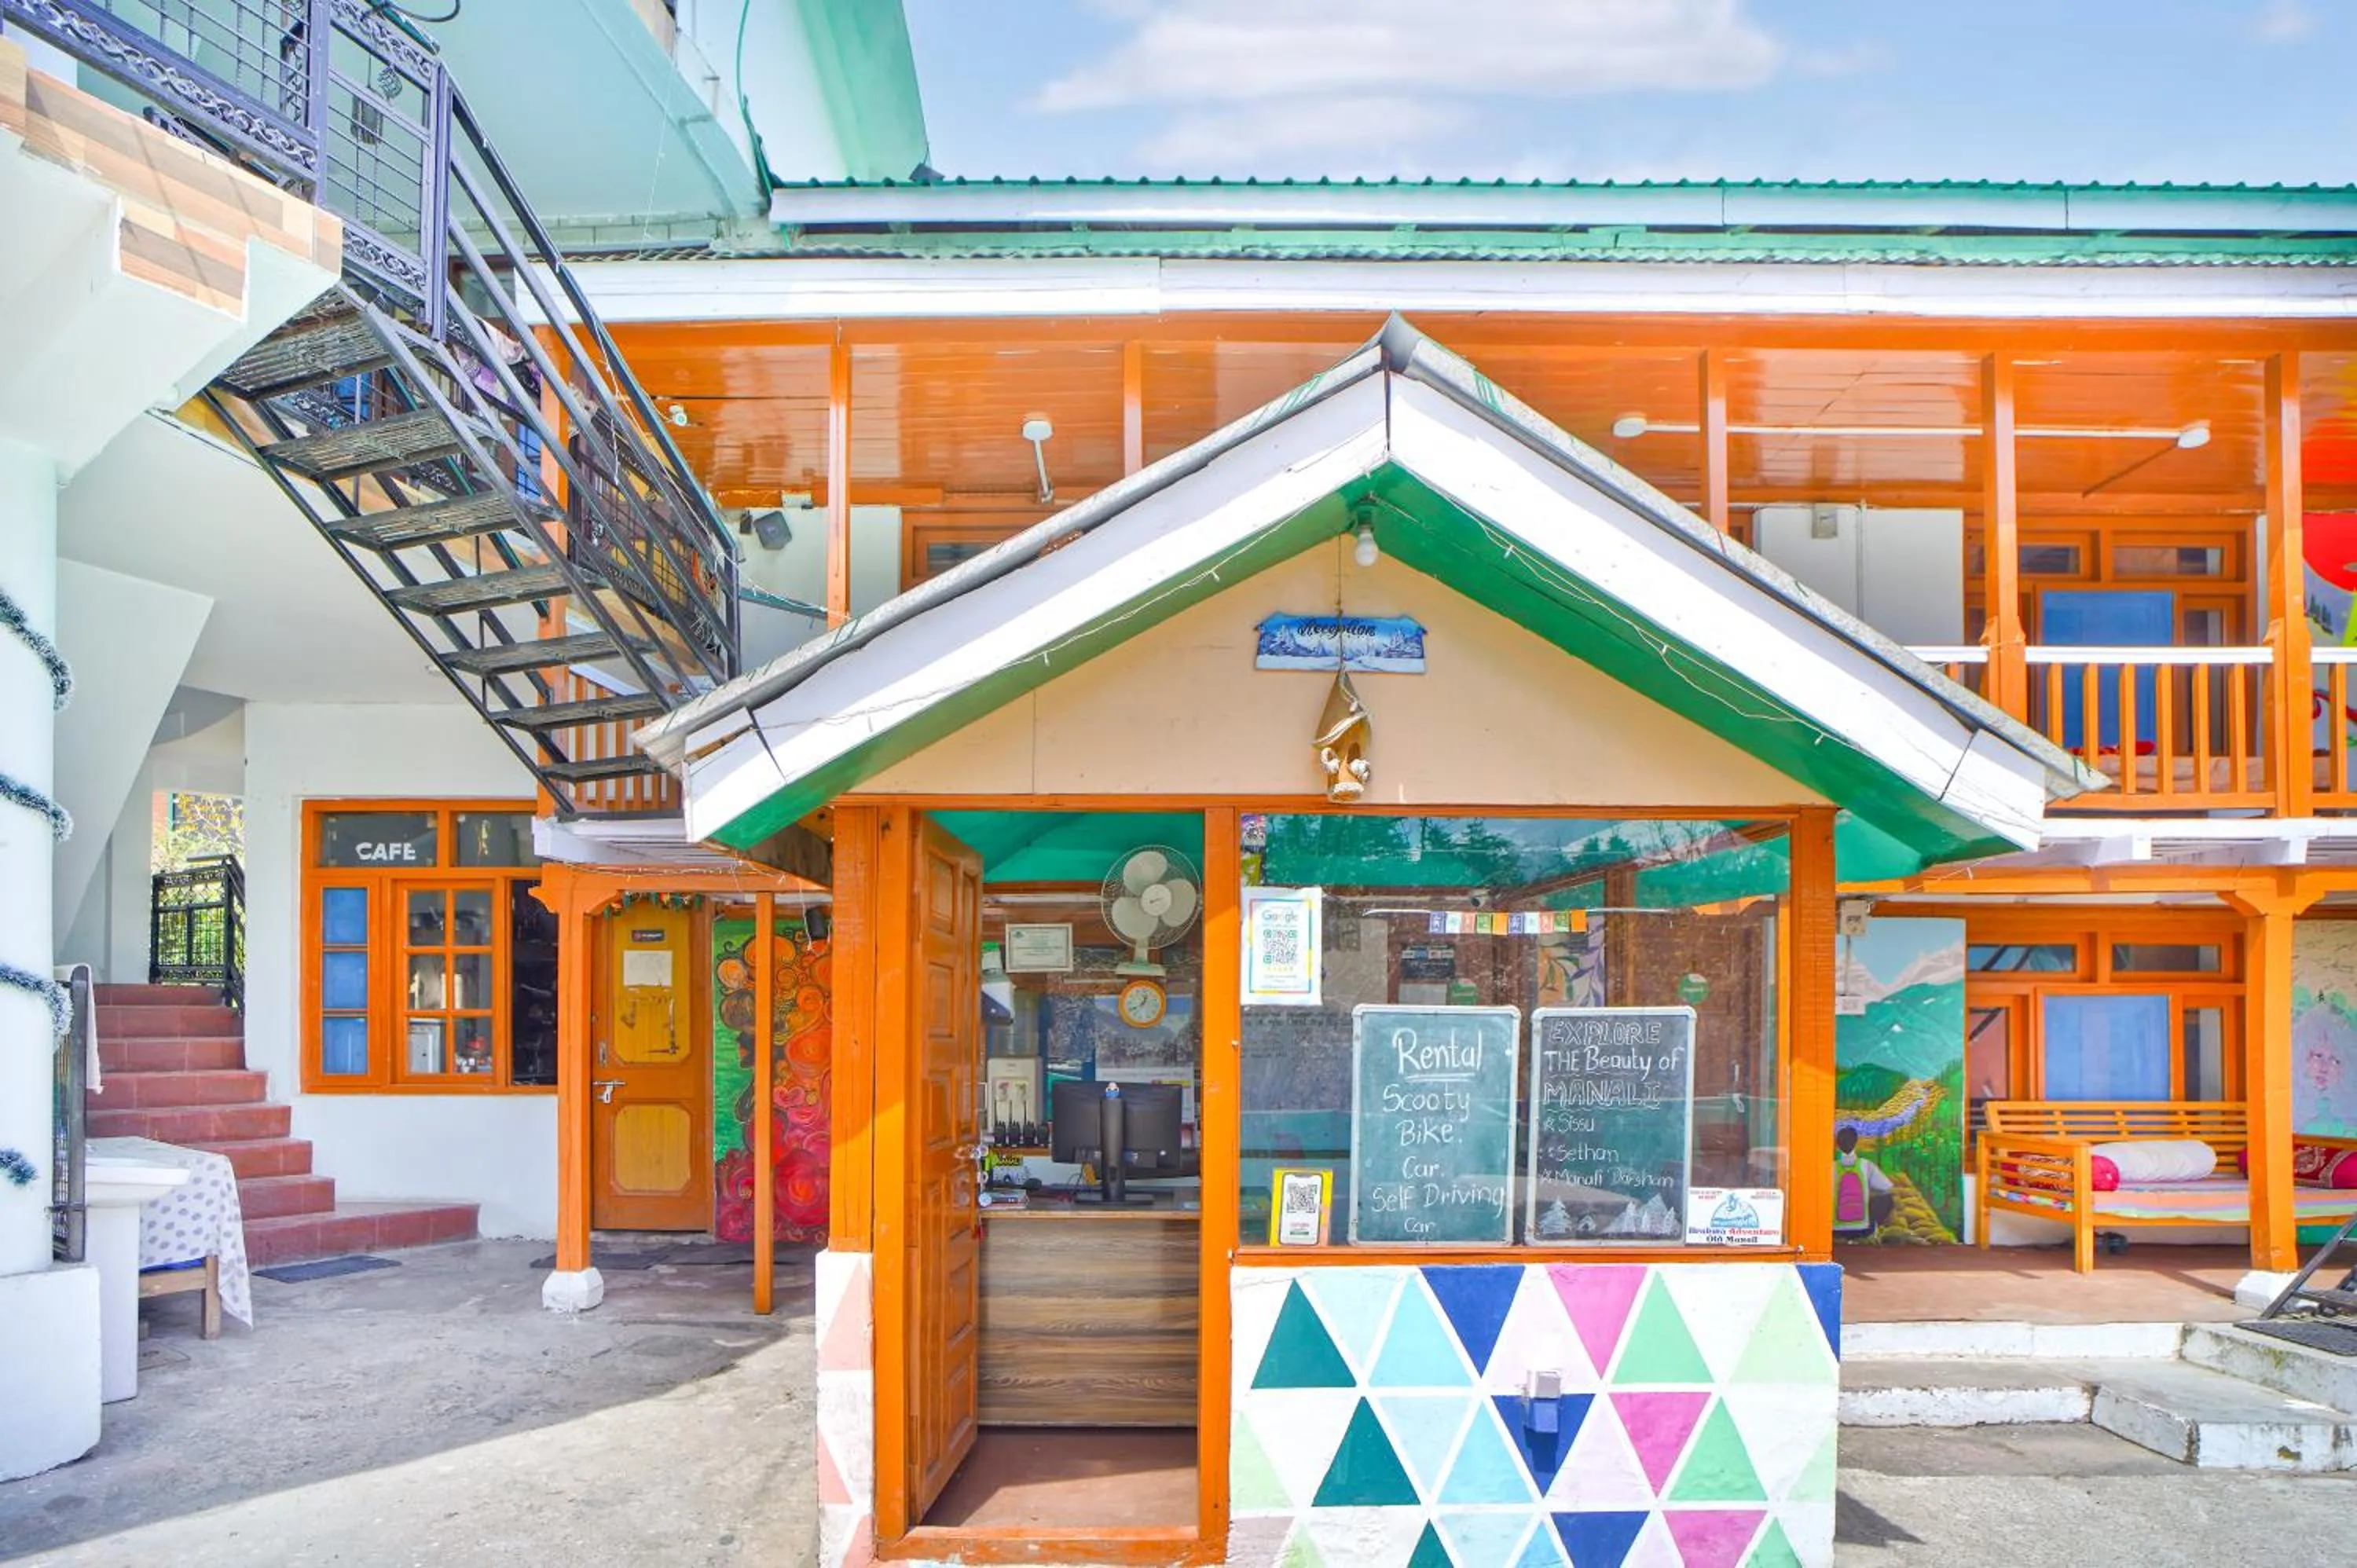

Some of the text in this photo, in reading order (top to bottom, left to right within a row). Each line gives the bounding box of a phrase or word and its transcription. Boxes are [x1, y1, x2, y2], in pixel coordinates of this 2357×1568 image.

[1297, 616, 1376, 639] Reception
[355, 841, 416, 860] CAFE
[1262, 910, 1298, 923] Google
[1549, 1020, 1662, 1045] EXPLORE
[1392, 1027, 1483, 1075] Rental
[1542, 1044, 1685, 1082] THE Beauty of
[1382, 1082, 1470, 1123] Scooty
[1543, 1079, 1661, 1108] MANALI
[1558, 1112, 1595, 1133] Sissu
[1556, 1142, 1620, 1163] Sethan
[1422, 1181, 1505, 1219] Driving
[1404, 1217, 1438, 1233] Car
